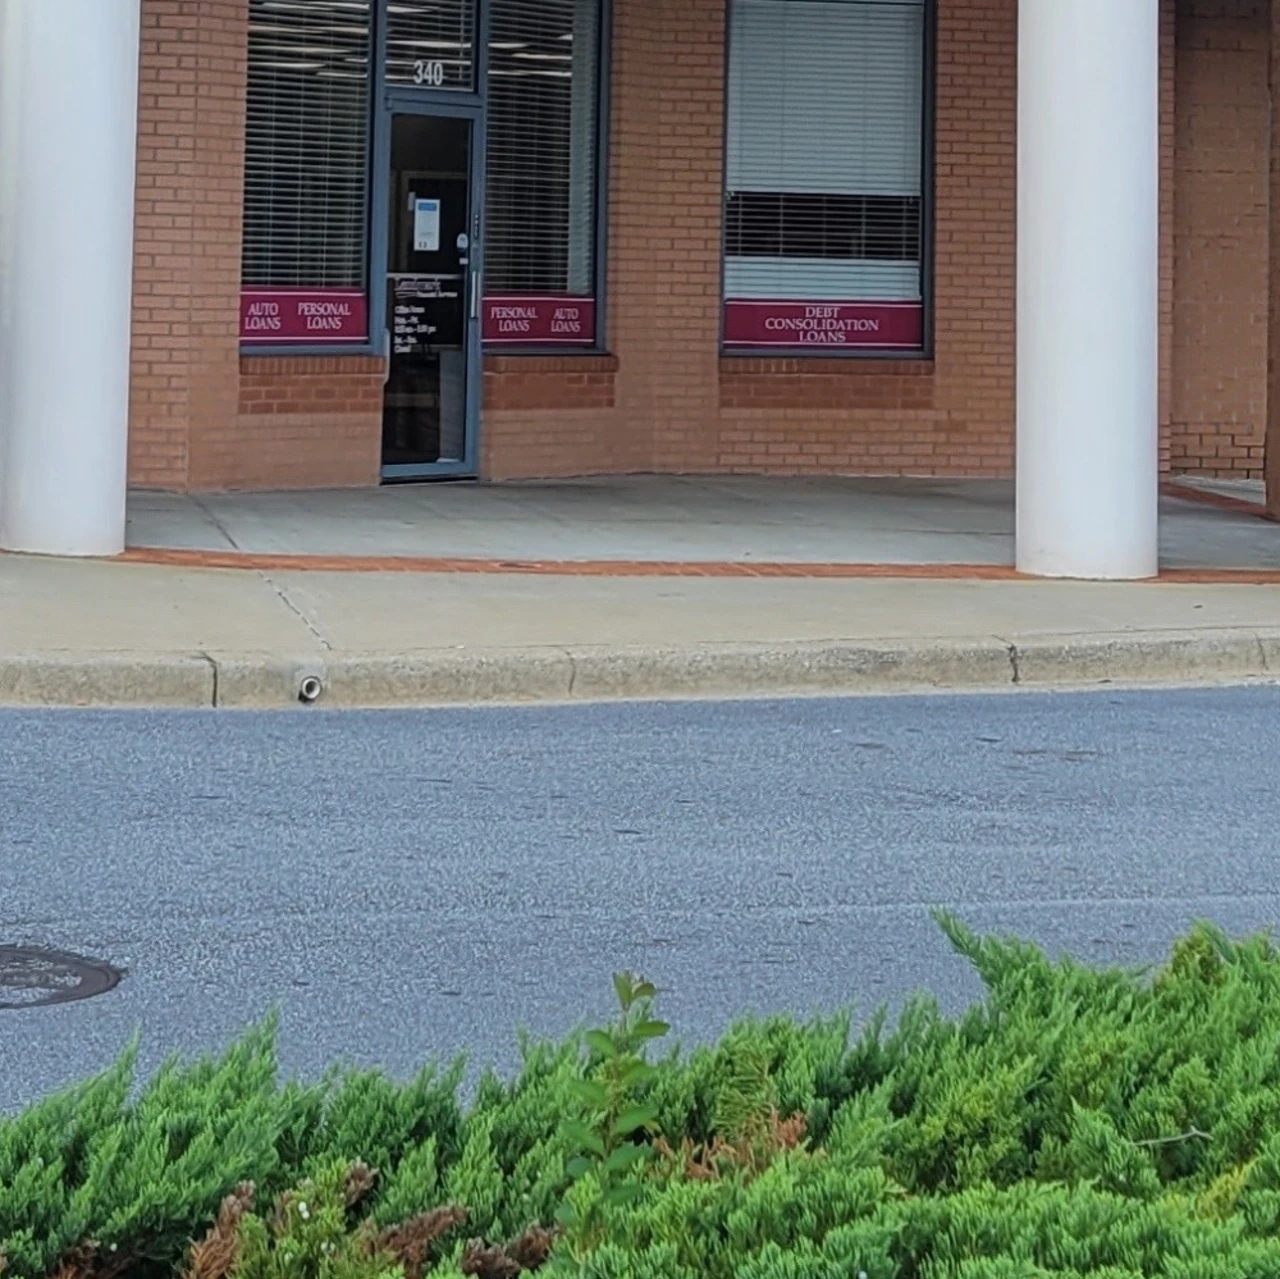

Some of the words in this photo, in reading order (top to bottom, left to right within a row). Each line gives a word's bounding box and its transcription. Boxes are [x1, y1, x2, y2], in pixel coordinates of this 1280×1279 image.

[413, 60, 444, 86] 340
[247, 302, 279, 316] AUTO
[297, 302, 351, 316] PERSONAL
[490, 306, 539, 319] PERSONAL
[553, 308, 580, 320] AUTO
[805, 306, 841, 318] DEBT
[244, 317, 281, 330] LOANS
[306, 317, 342, 330] LOANS
[499, 320, 531, 332] LOANS
[551, 321, 581, 333] LOANS
[764, 318, 880, 331] CONSOLIDATION
[799, 331, 847, 342] LOANS
